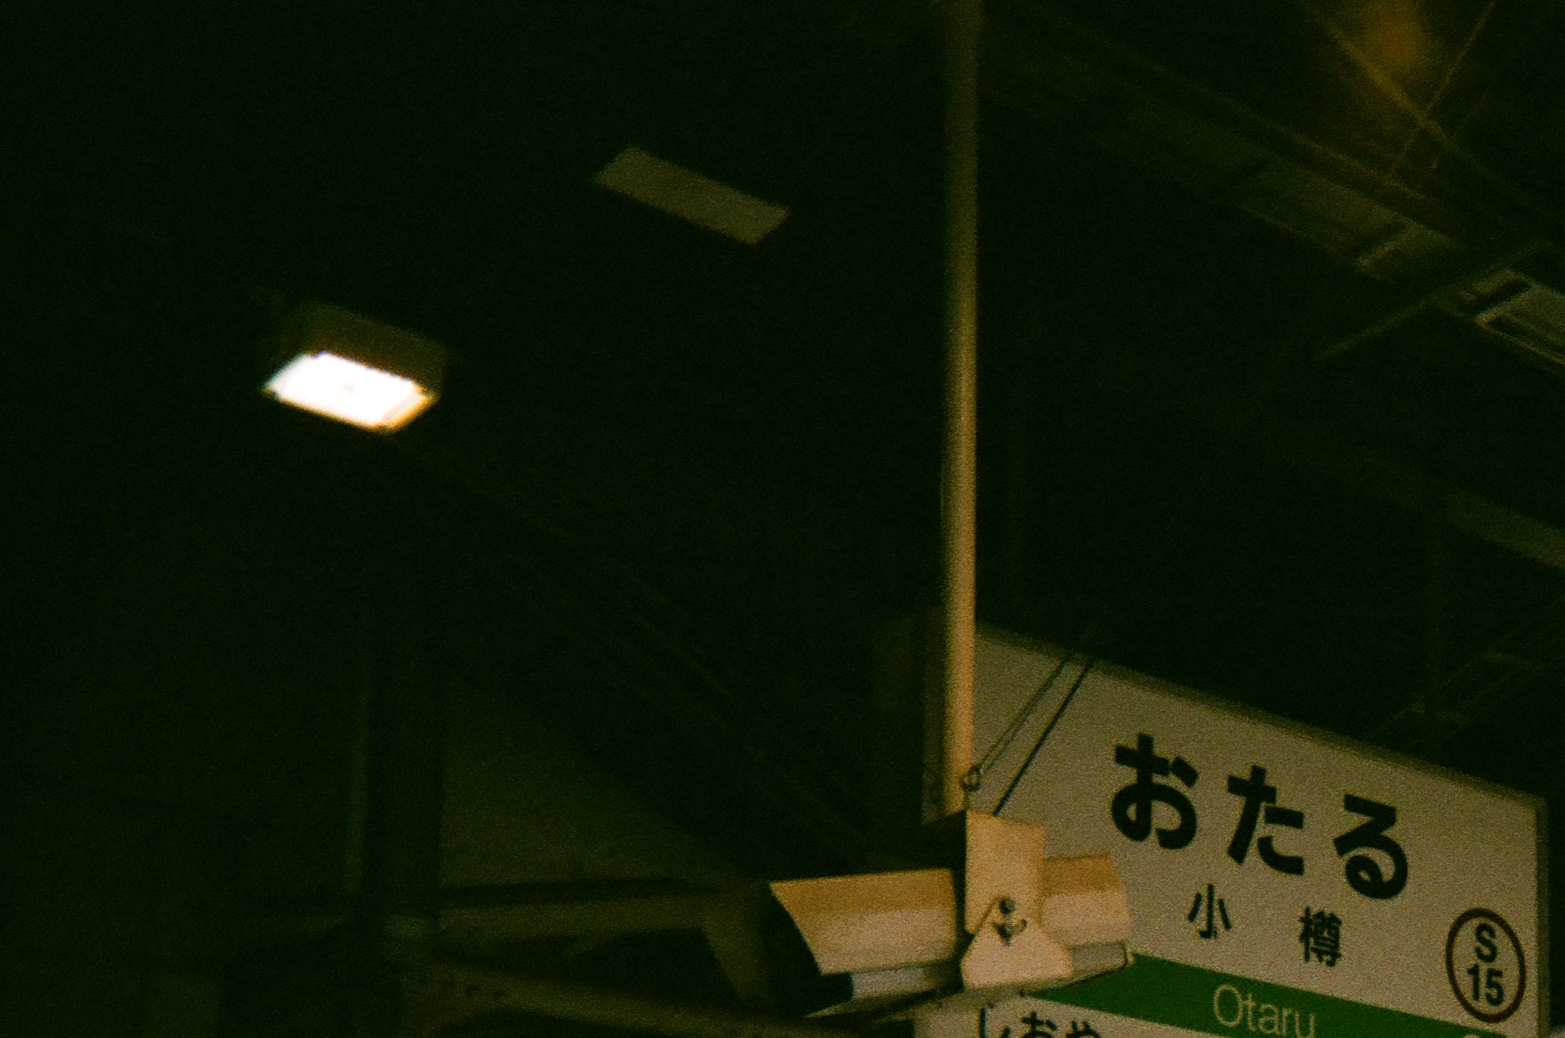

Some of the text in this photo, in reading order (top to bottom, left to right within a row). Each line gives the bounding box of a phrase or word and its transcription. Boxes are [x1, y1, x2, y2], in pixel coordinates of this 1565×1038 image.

[1111, 732, 1408, 900] おたる
[1187, 883, 1343, 967] 小樽
[1474, 923, 1498, 965] S
[1466, 965, 1505, 1008] 15
